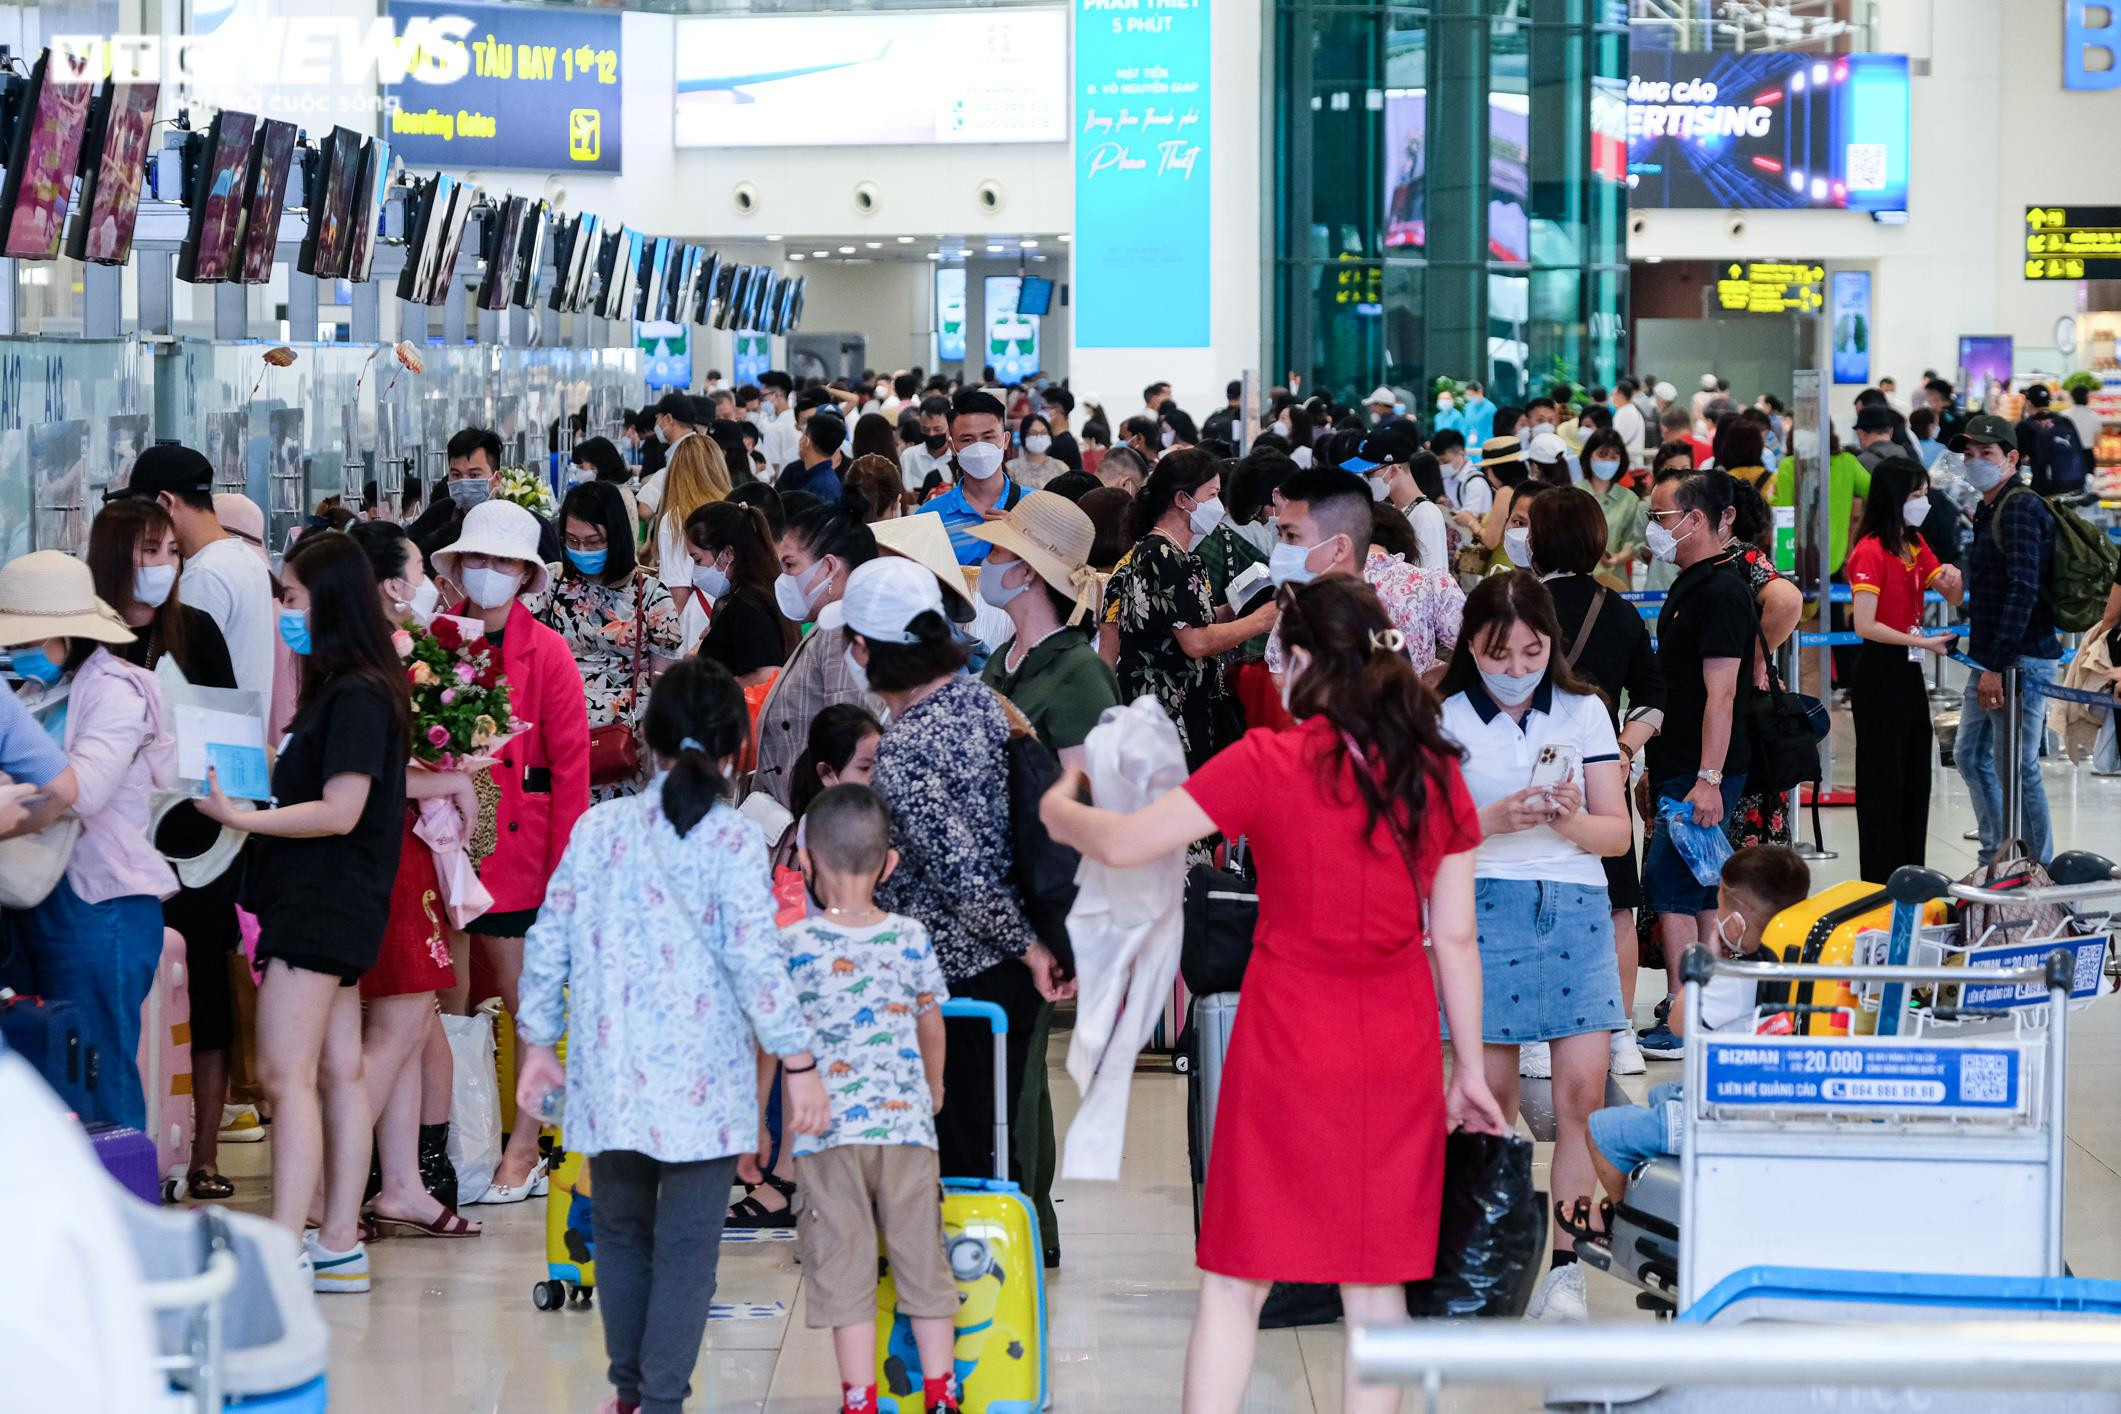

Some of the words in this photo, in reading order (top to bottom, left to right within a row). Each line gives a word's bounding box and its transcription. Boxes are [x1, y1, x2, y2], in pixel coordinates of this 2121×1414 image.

[1127, 13, 1173, 32] PHÚT
[473, 34, 512, 79] TÀU
[518, 45, 556, 80] BAY
[595, 49, 617, 84] 12
[1627, 75, 1671, 102] ẢNG
[1671, 77, 1718, 103] CÁO
[1627, 105, 1773, 138] ERTISING
[45, 354, 63, 422] A13
[1718, 1049, 1780, 1065] BIZMAN
[1805, 1050, 1864, 1074] 20.000
[1718, 1081, 1742, 1096] LIÊN
[1743, 1080, 1757, 1098] HỆ
[1759, 1079, 1794, 1097] QUẢNG
[1795, 1081, 1818, 1097] CÁO
